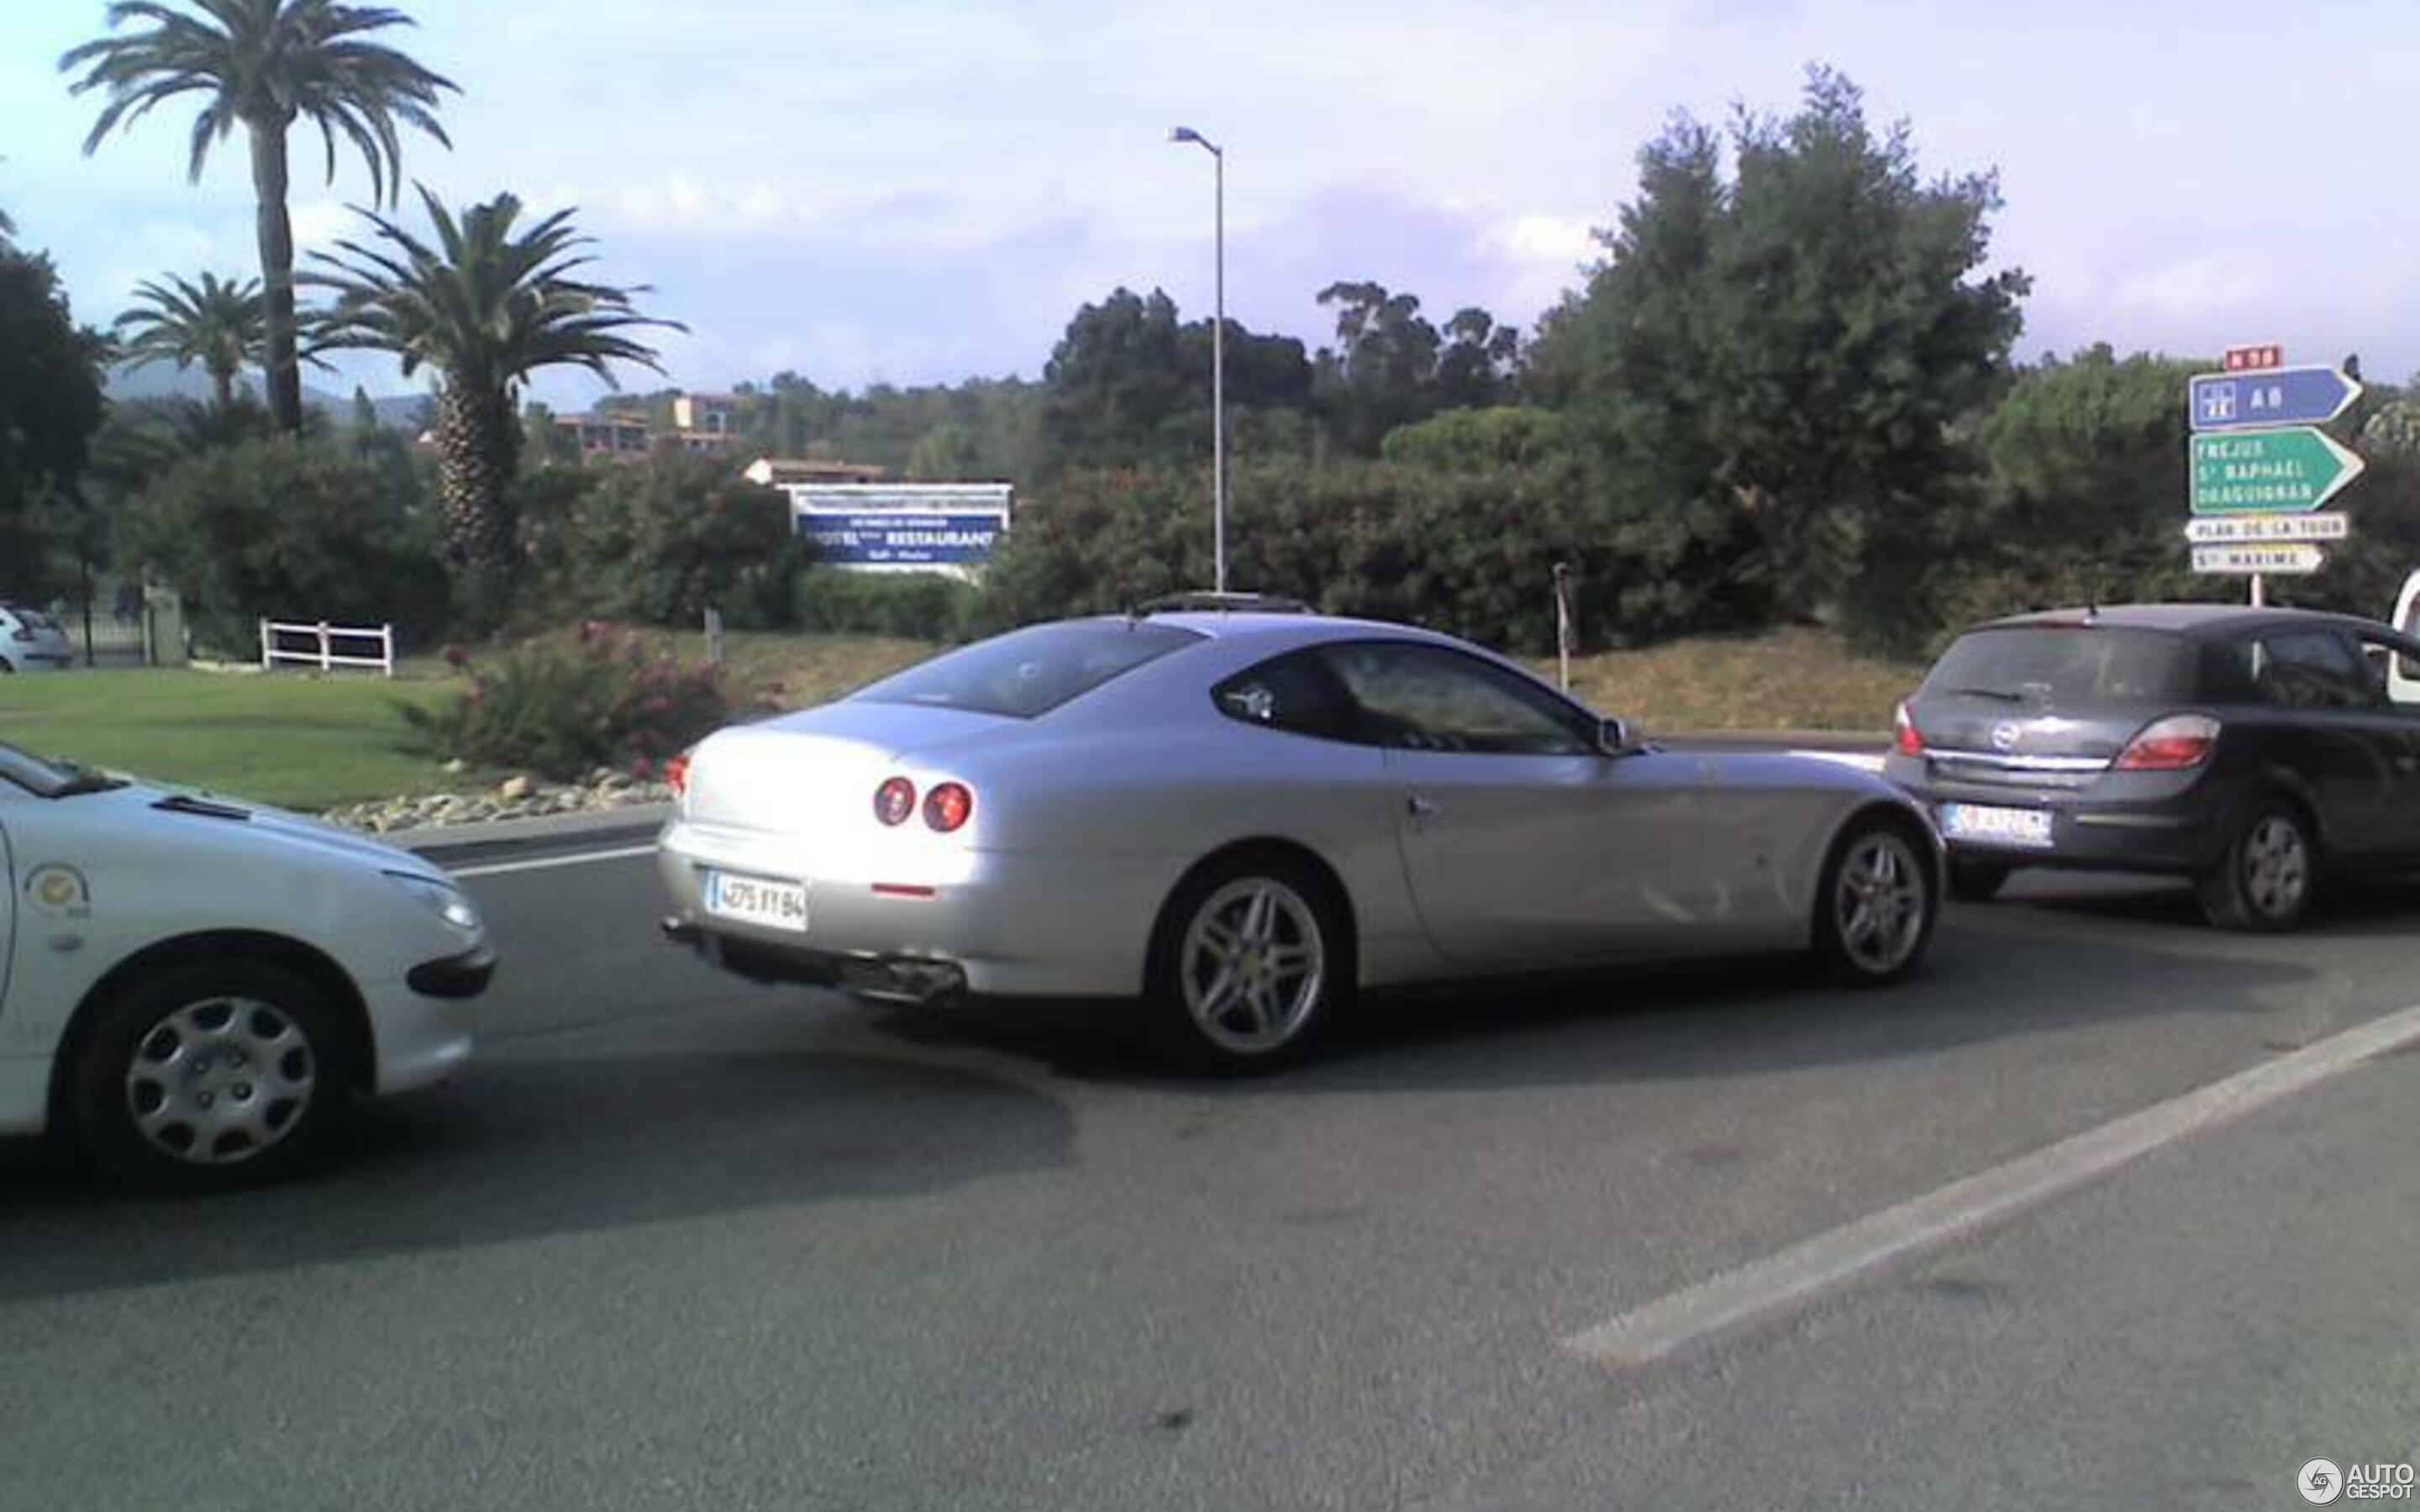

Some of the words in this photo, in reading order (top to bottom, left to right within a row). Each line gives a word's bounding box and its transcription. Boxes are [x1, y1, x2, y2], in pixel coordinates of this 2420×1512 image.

[2197, 482, 2312, 504] DRAGUIGNAN
[2196, 524, 2233, 536] PLAN
[2244, 522, 2262, 535] DE
[2274, 521, 2291, 534] LA
[2301, 519, 2342, 534] TOUR
[885, 531, 993, 546] RESTAURANT
[2228, 553, 2298, 564] MAXIME
